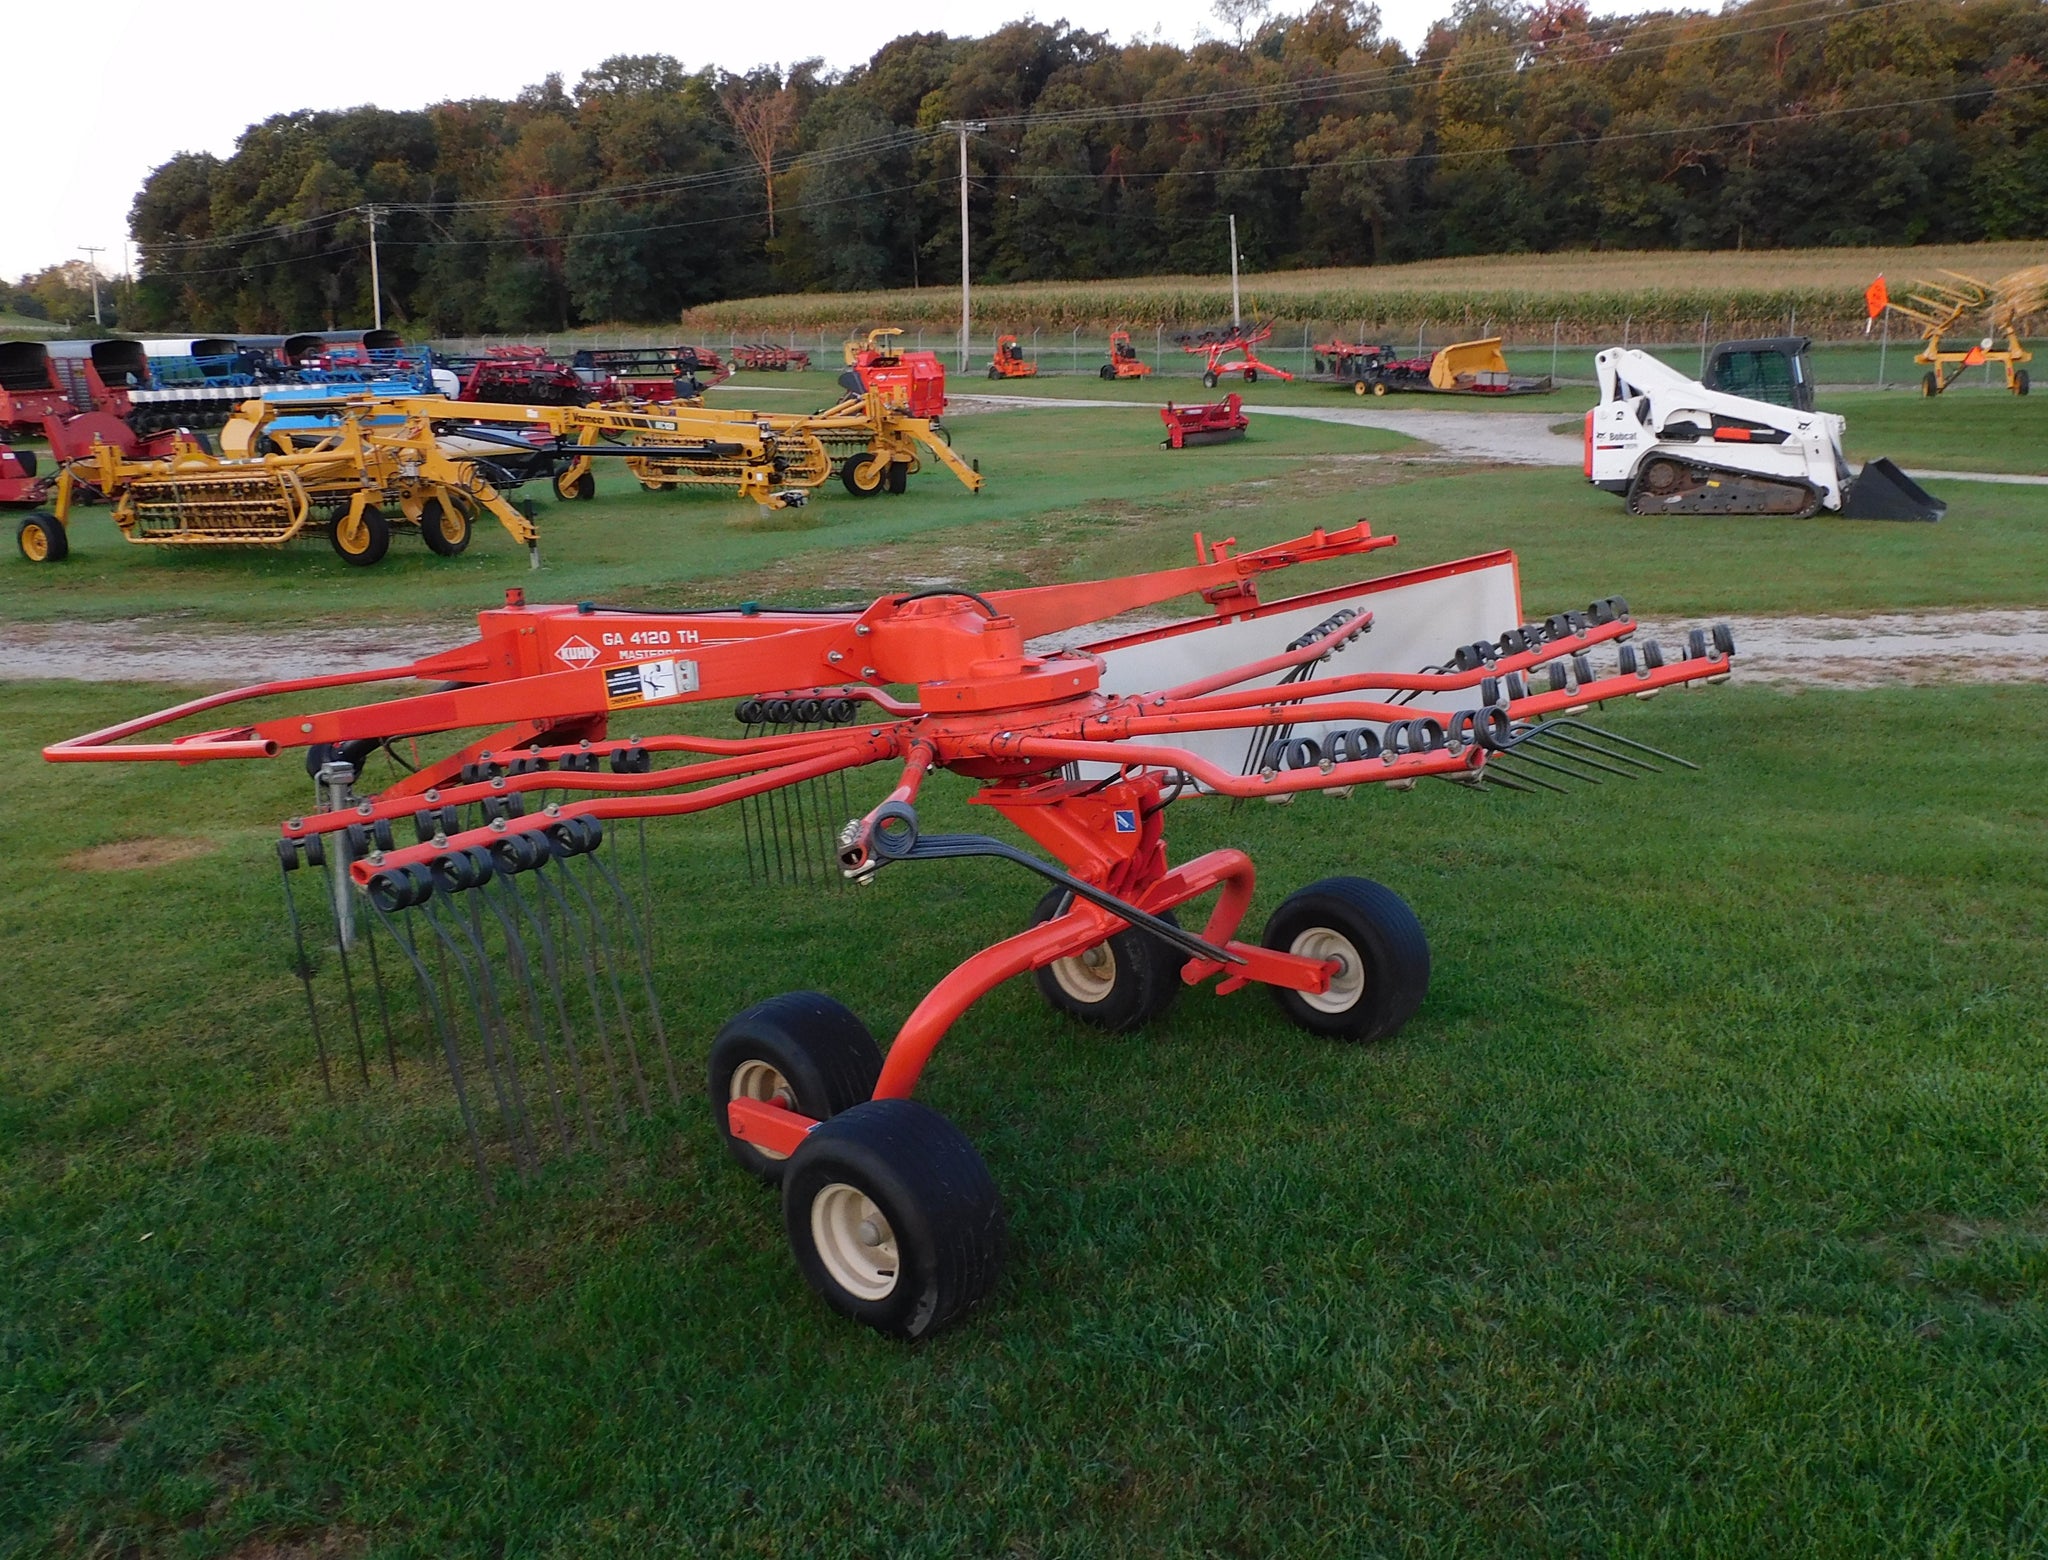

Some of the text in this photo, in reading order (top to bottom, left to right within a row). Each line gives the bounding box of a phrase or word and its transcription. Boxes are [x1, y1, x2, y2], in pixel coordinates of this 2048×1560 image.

[1609, 432, 1637, 441] Bobcat
[602, 630, 699, 646] GA 4120 TH
[560, 646, 595, 660] KUHN
